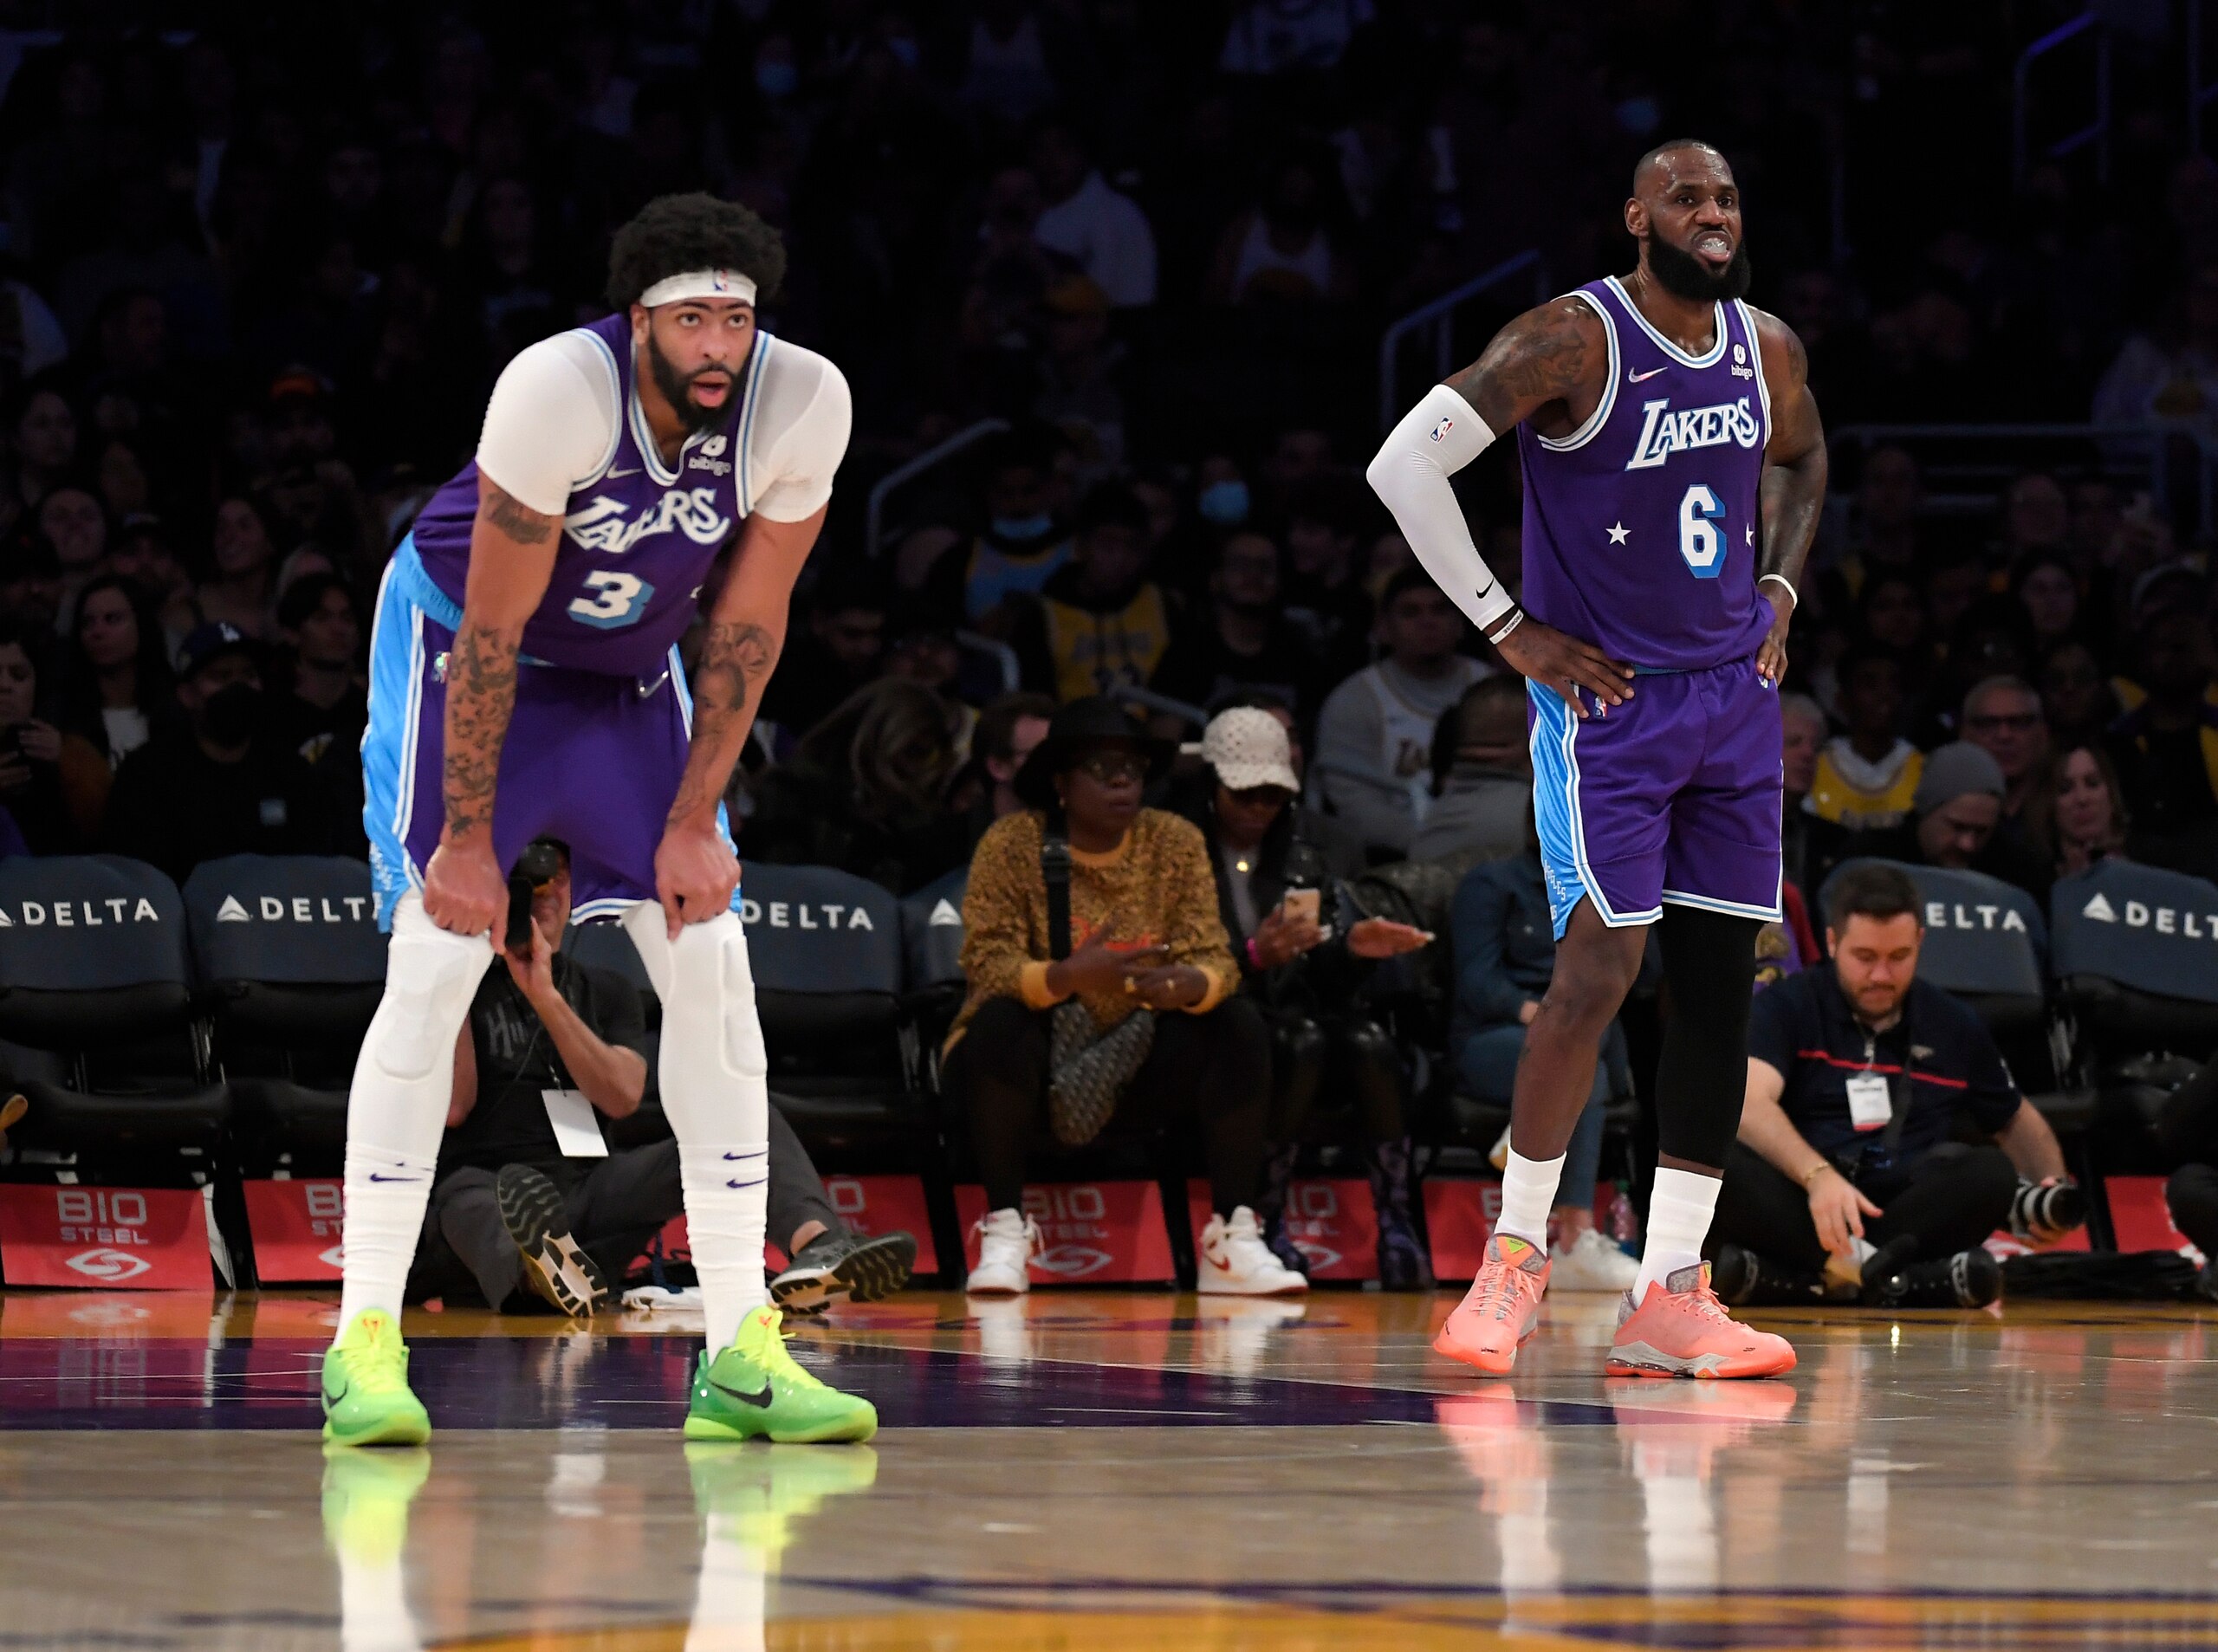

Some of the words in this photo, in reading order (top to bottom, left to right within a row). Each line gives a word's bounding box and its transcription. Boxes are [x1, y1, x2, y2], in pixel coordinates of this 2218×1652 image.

[1731, 364, 1753, 380] bibigo
[1625, 395, 1759, 471] LAKERS
[1678, 483, 1727, 578] 6
[567, 569, 654, 629] 3
[22, 897, 159, 927] DELTA
[740, 898, 874, 930] DELTA
[1924, 902, 2027, 933] ELTA
[2125, 900, 2218, 941] DELT
[56, 1189, 147, 1225] BIO
[1287, 1184, 1338, 1219] IO
[59, 1226, 151, 1246] STEEL
